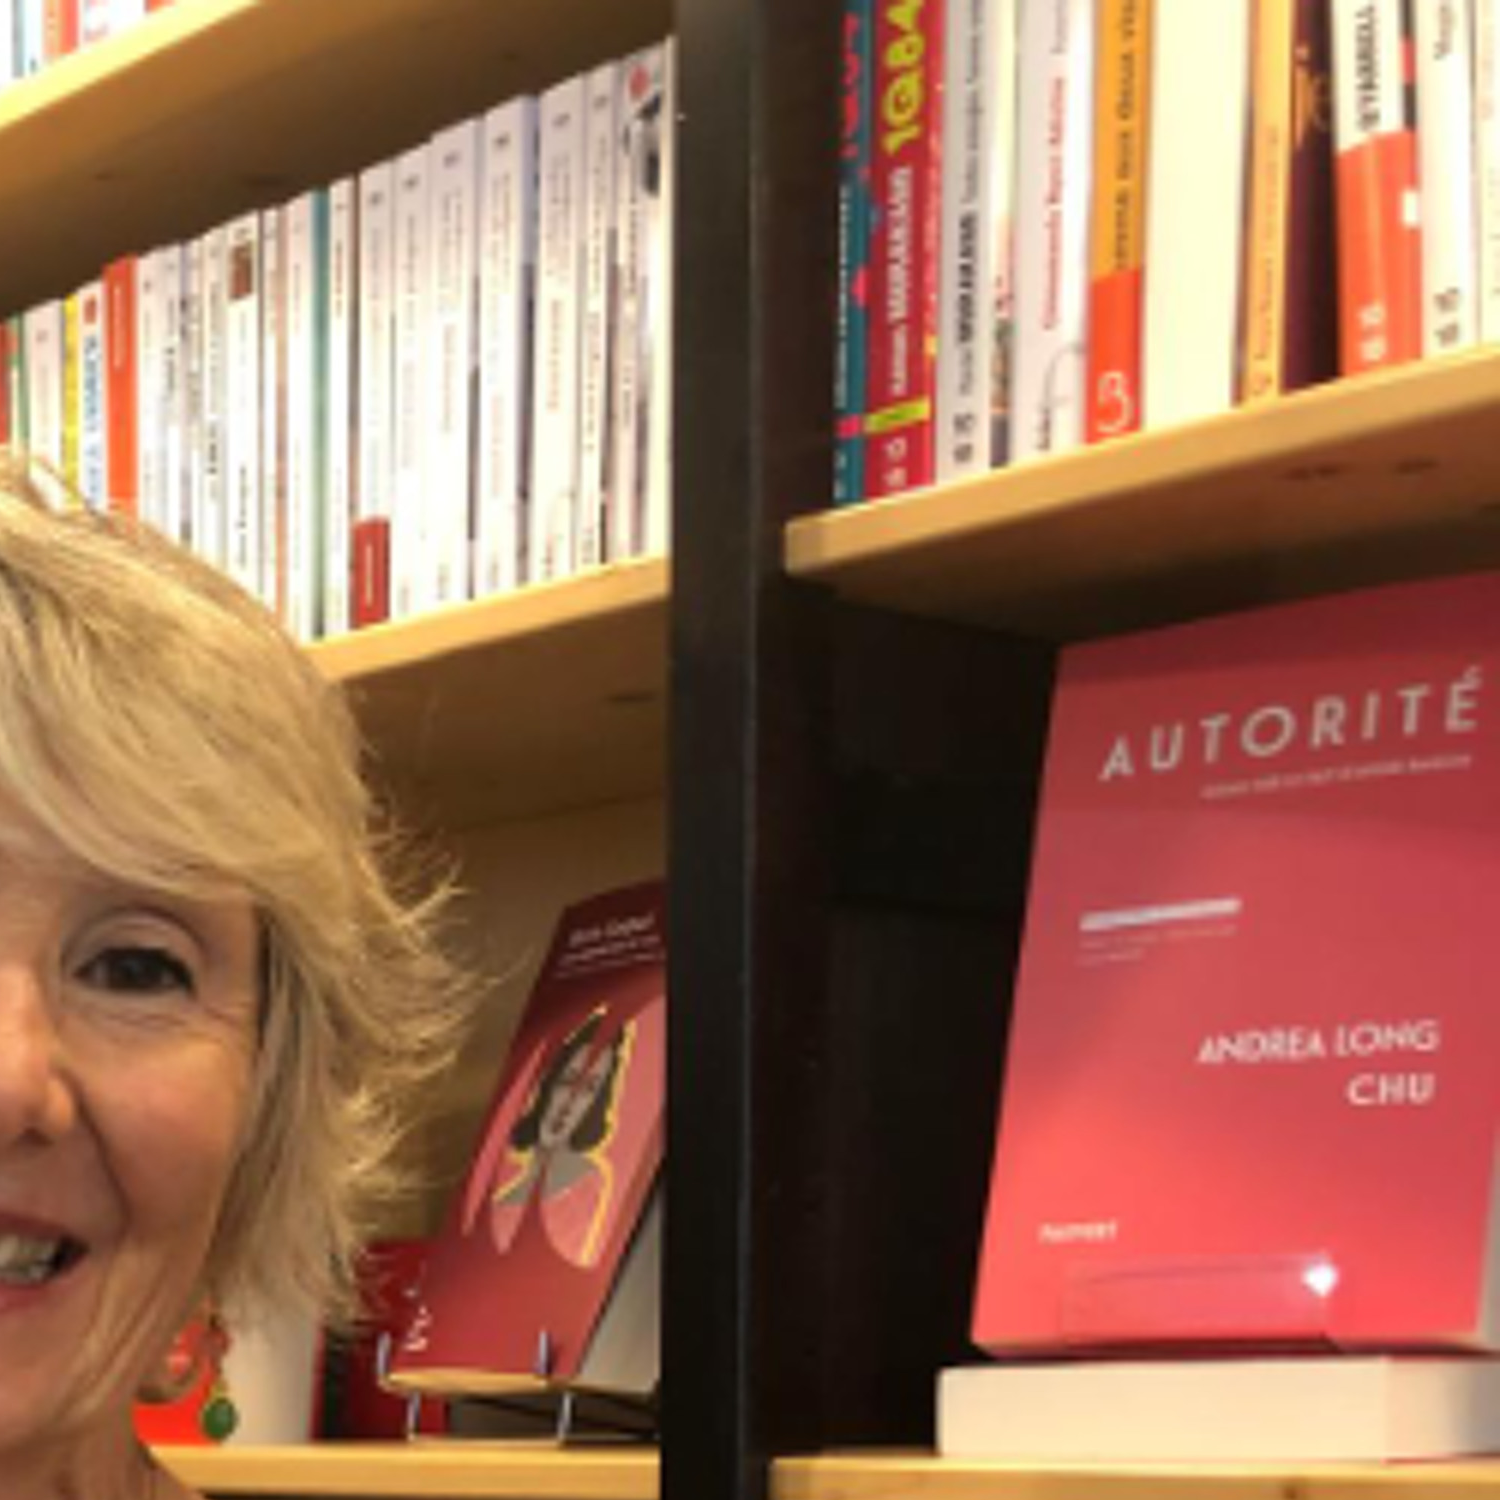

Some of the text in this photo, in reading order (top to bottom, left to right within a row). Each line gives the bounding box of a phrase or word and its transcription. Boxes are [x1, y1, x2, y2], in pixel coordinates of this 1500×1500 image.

[1100, 667, 1481, 781] AUTORITÉ
[1198, 1021, 1439, 1064] ANDREA LONG
[1346, 1074, 1436, 1106] CHU
